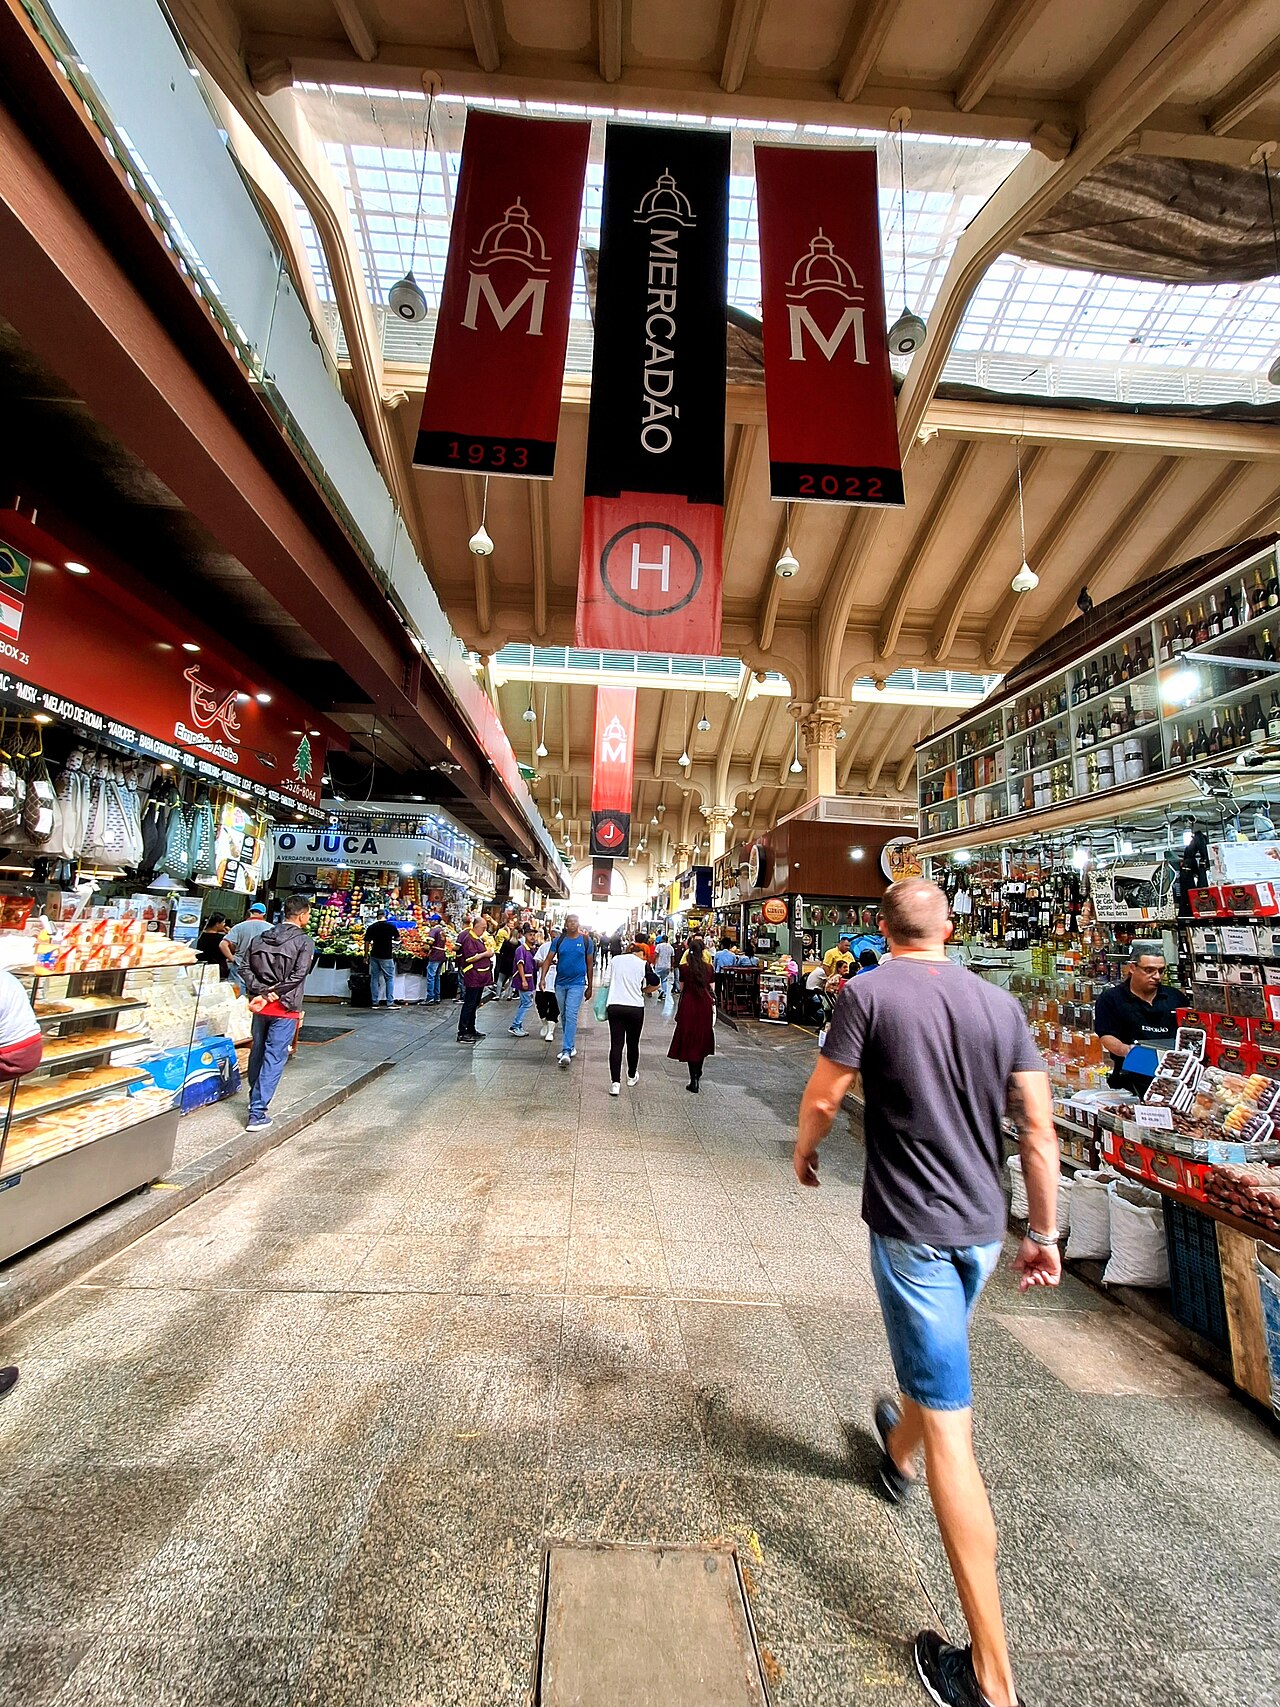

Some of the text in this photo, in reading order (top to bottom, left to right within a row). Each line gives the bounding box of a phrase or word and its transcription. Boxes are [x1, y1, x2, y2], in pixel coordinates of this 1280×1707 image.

[460, 270, 549, 336] M
[640, 228, 680, 454] MERCADÃO
[786, 304, 870, 365] M
[447, 441, 529, 468] 1933
[799, 474, 884, 498] 2022
[630, 543, 670, 592] H
[0, 640, 30, 665] BOX 25
[601, 741, 627, 763] M
[306, 835, 378, 855] JUCA
[604, 825, 615, 839] J
